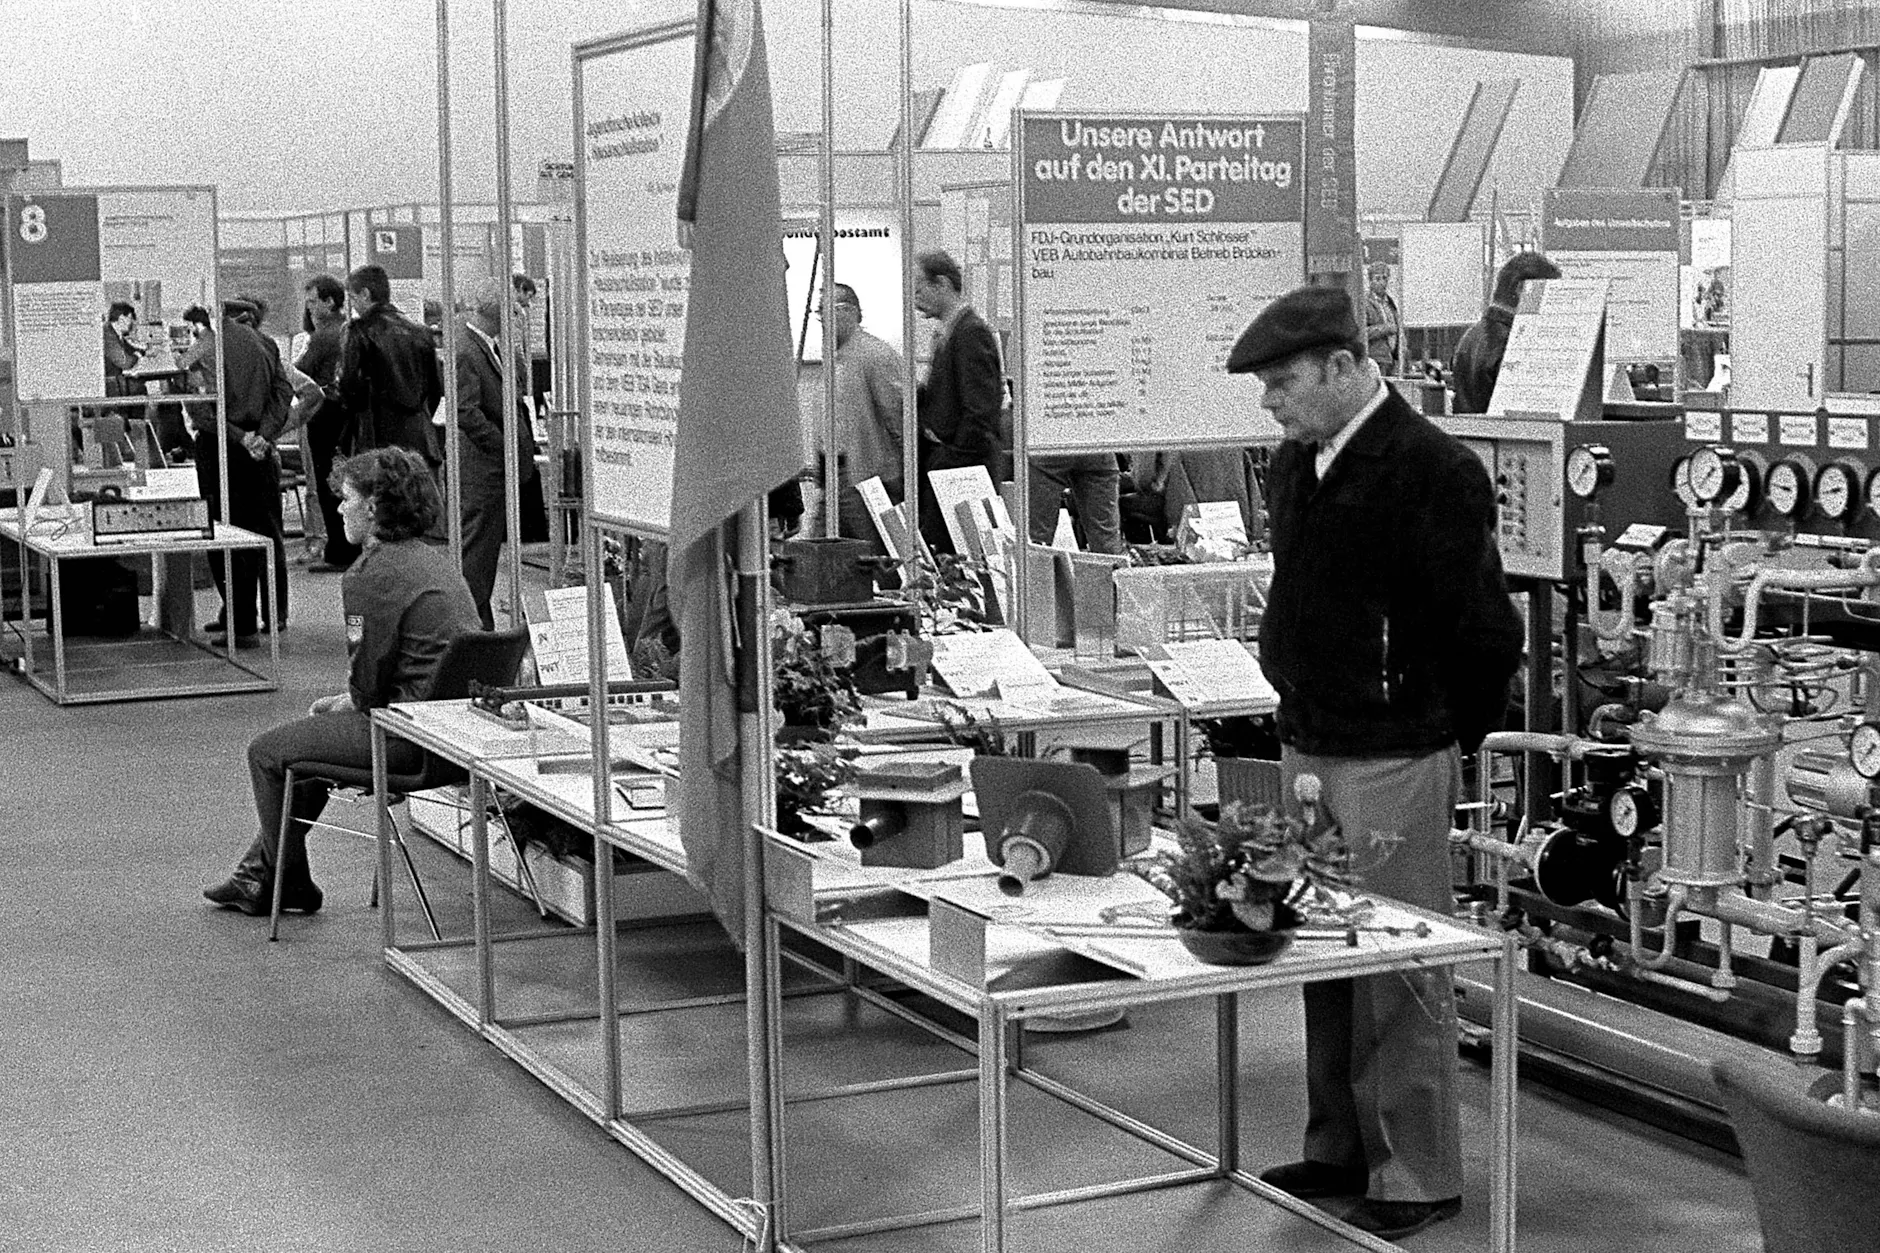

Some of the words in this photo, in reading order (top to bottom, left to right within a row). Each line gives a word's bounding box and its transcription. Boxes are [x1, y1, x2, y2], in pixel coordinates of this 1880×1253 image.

[1061, 120, 1153, 148] Unsere
[1158, 121, 1266, 149] Antwort
[1034, 154, 1081, 181] auf
[1086, 153, 1134, 181] den
[1140, 154, 1172, 181] XI.
[1175, 154, 1293, 188] Parteitag
[1117, 187, 1159, 215] der
[1163, 187, 1215, 214] SED
[19, 204, 48, 244] 8
[1031, 230, 1163, 247] FDJ-Grundorganisation
[1031, 249, 1060, 263] VEB
[1191, 246, 1230, 260] Betrieb
[1031, 267, 1054, 280] bau
